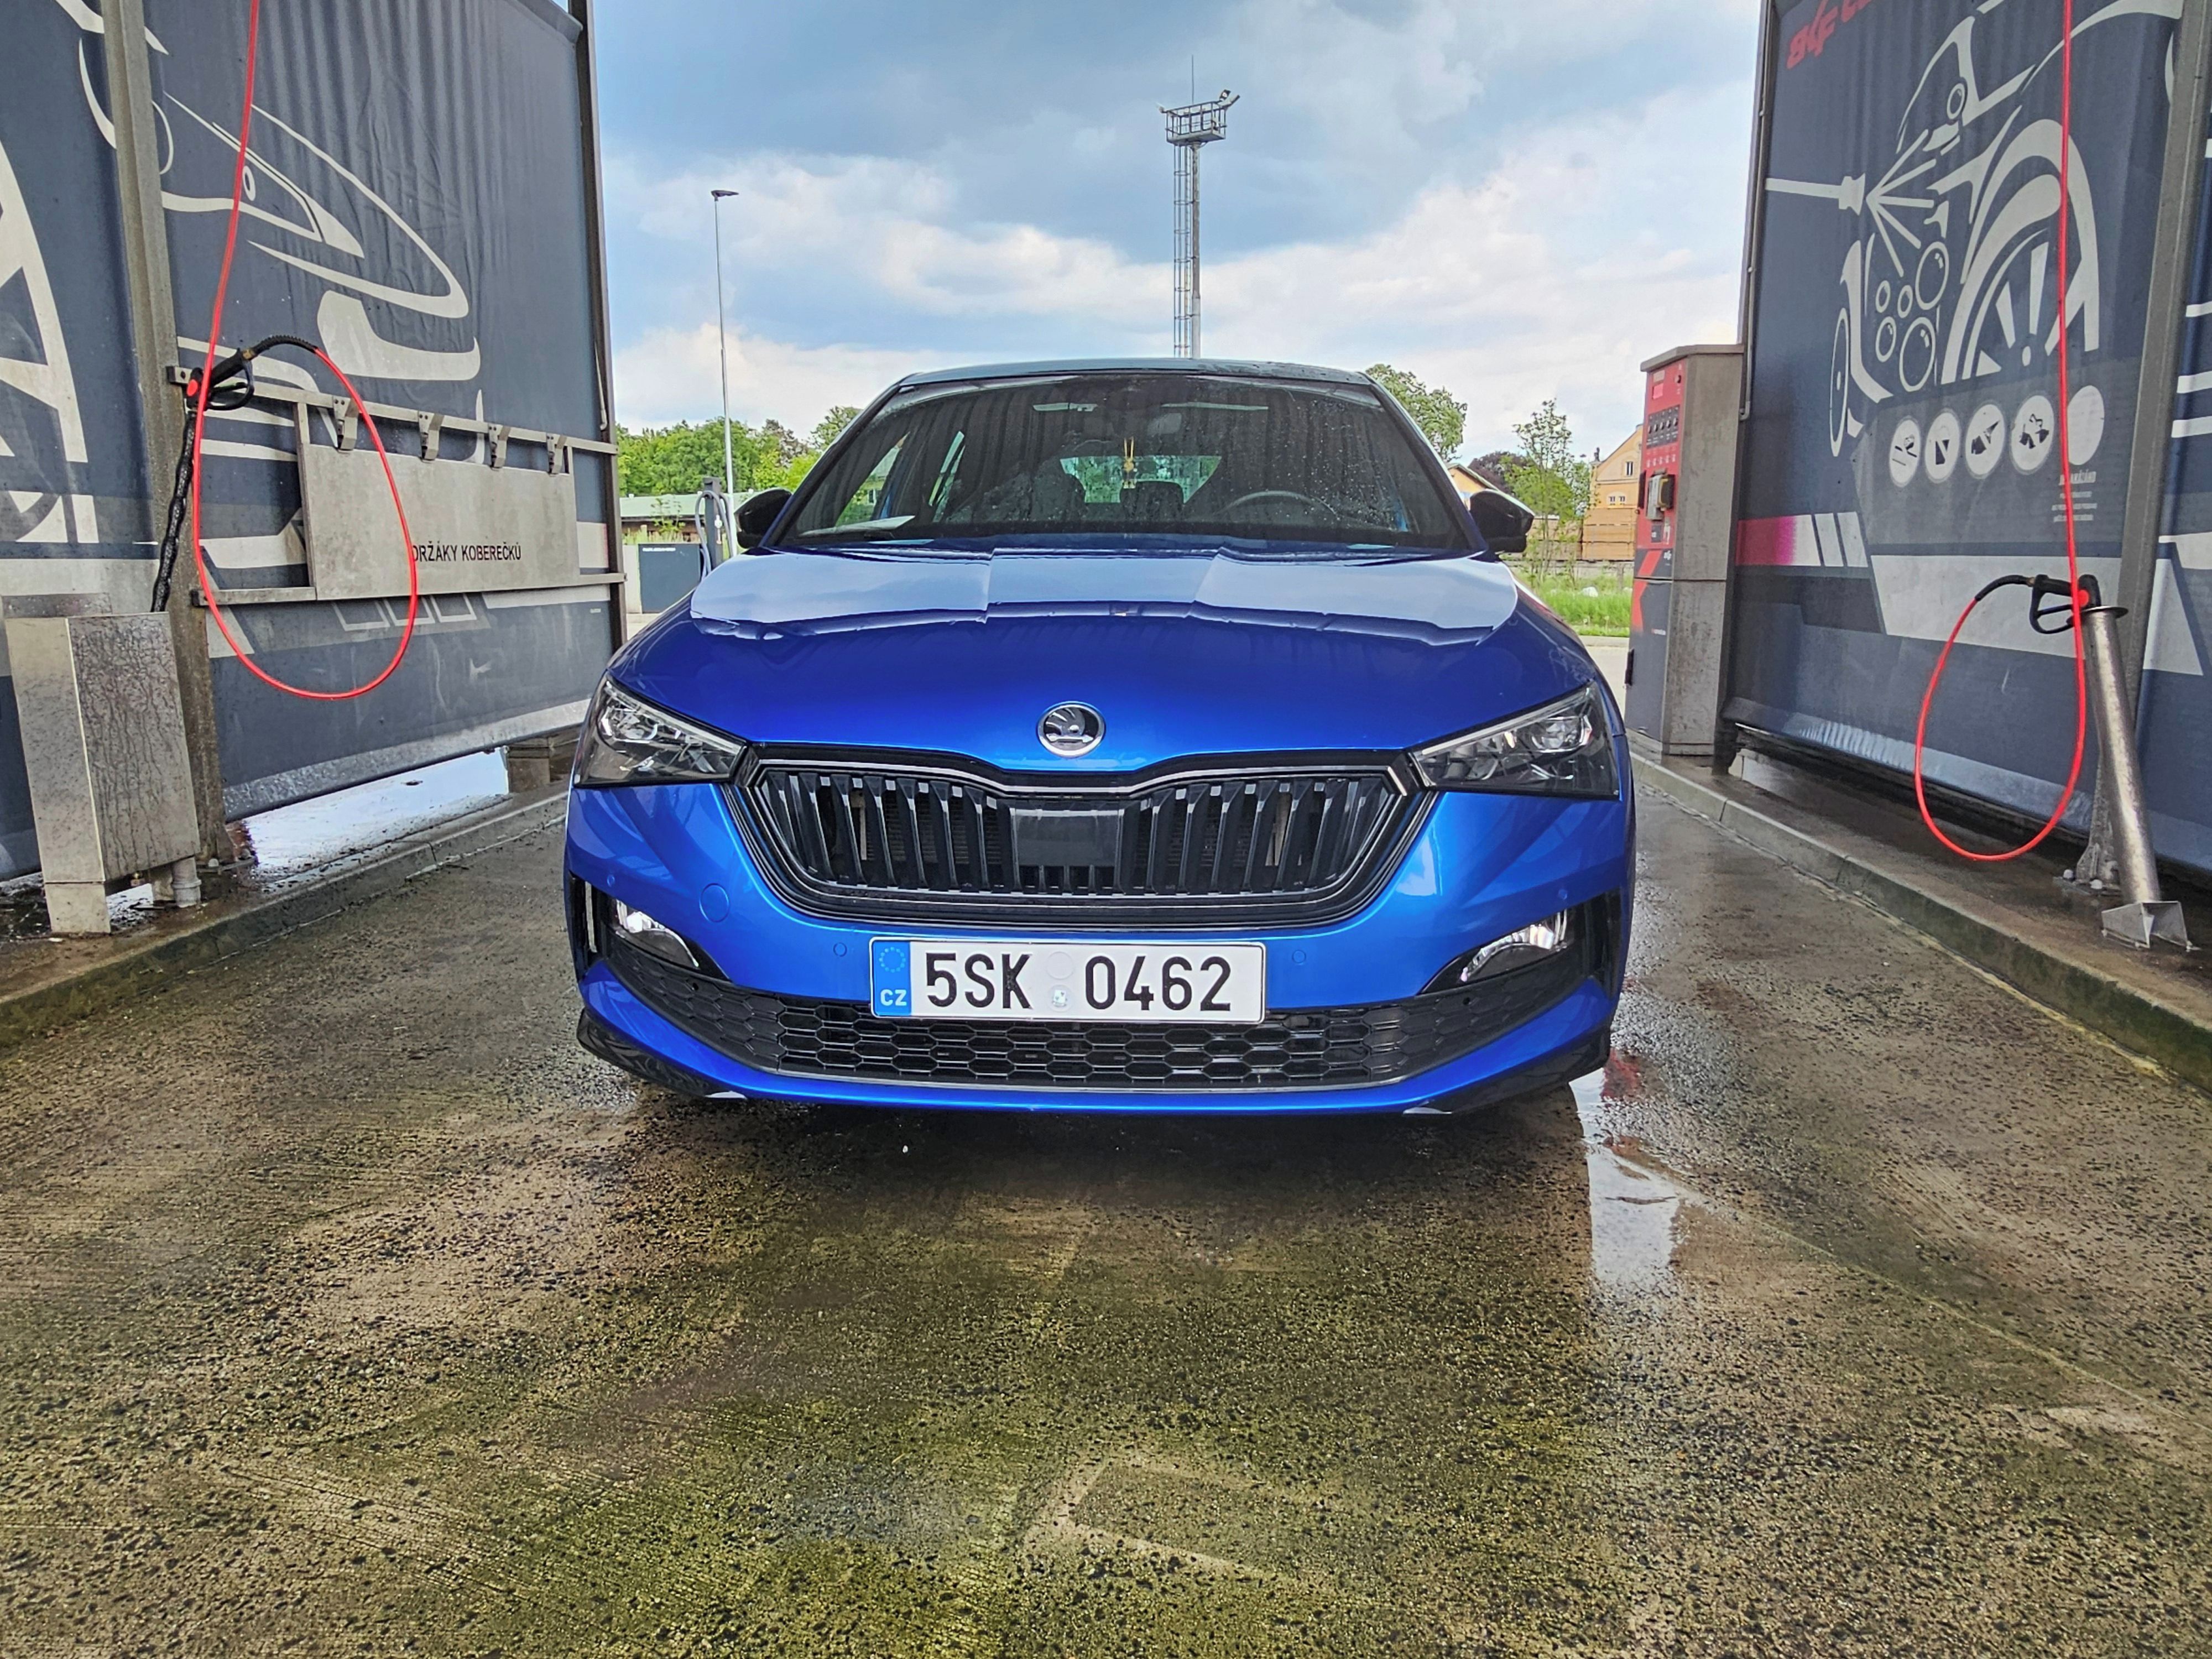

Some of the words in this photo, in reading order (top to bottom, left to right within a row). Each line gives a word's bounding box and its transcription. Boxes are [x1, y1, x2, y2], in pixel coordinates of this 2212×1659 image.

[461, 541, 521, 561] KOBEREČKŮ
[926, 953, 1030, 1009] 5SK
[1086, 956, 1230, 1011] 0462
[880, 989, 907, 1006] CZ
